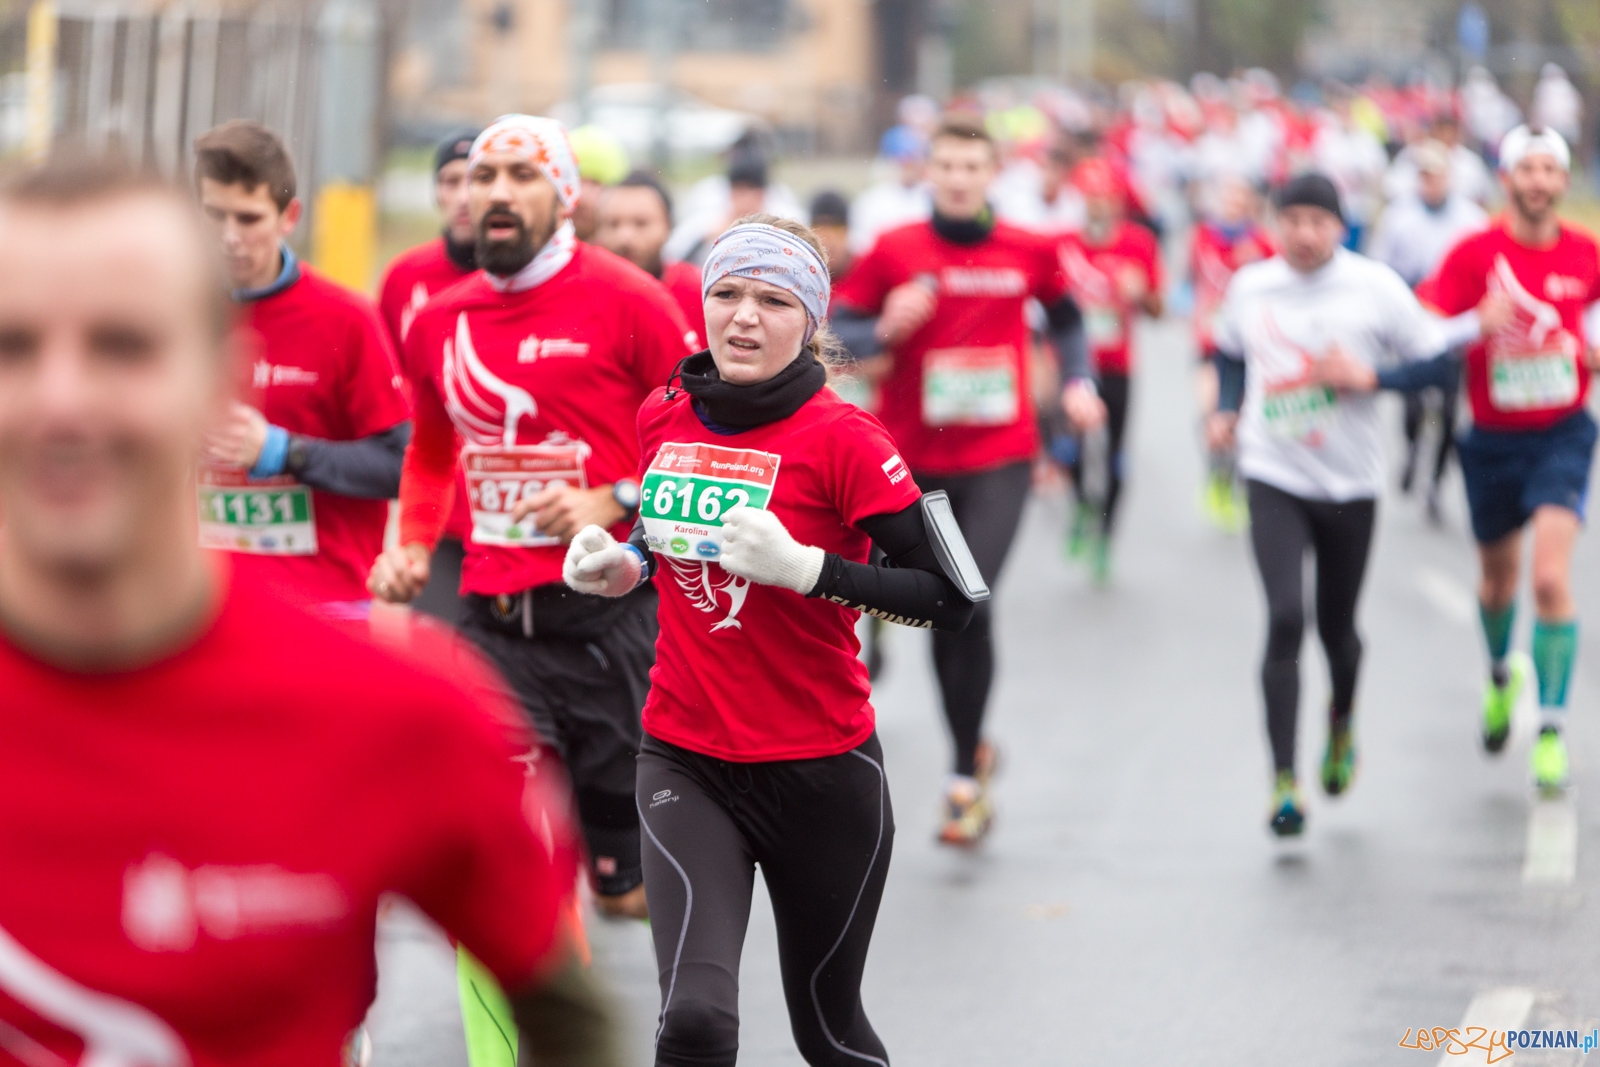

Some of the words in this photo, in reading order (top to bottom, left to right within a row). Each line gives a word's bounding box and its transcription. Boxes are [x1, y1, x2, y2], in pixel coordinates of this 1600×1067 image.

[757, 247, 781, 258] med
[730, 254, 754, 271] vigor
[764, 267, 790, 276] vigor
[710, 461, 765, 476] RunPoland.org
[211, 491, 294, 523] 1131
[642, 488, 652, 501] C
[653, 480, 750, 521] 6162
[674, 525, 709, 536] Karolina
